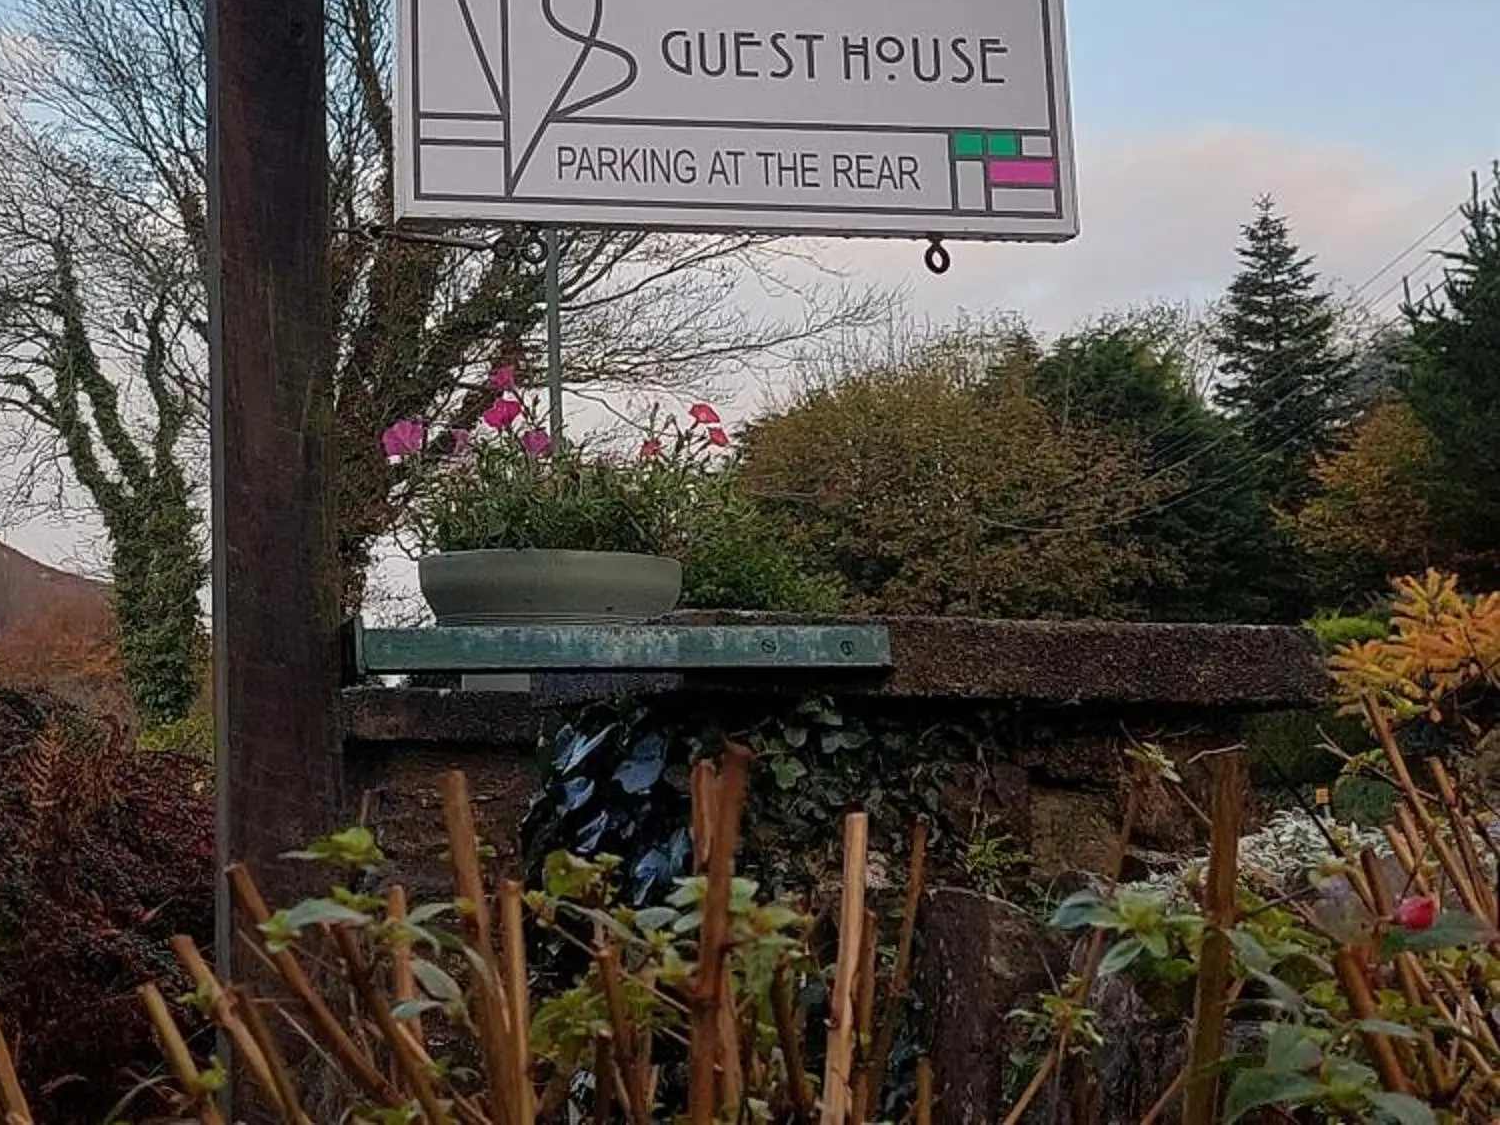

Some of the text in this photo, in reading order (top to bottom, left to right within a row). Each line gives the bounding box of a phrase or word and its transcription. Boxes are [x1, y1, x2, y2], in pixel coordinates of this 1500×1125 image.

[661, 30, 825, 79] GUEST
[557, 145, 921, 191] PARKING AT THE REAR
